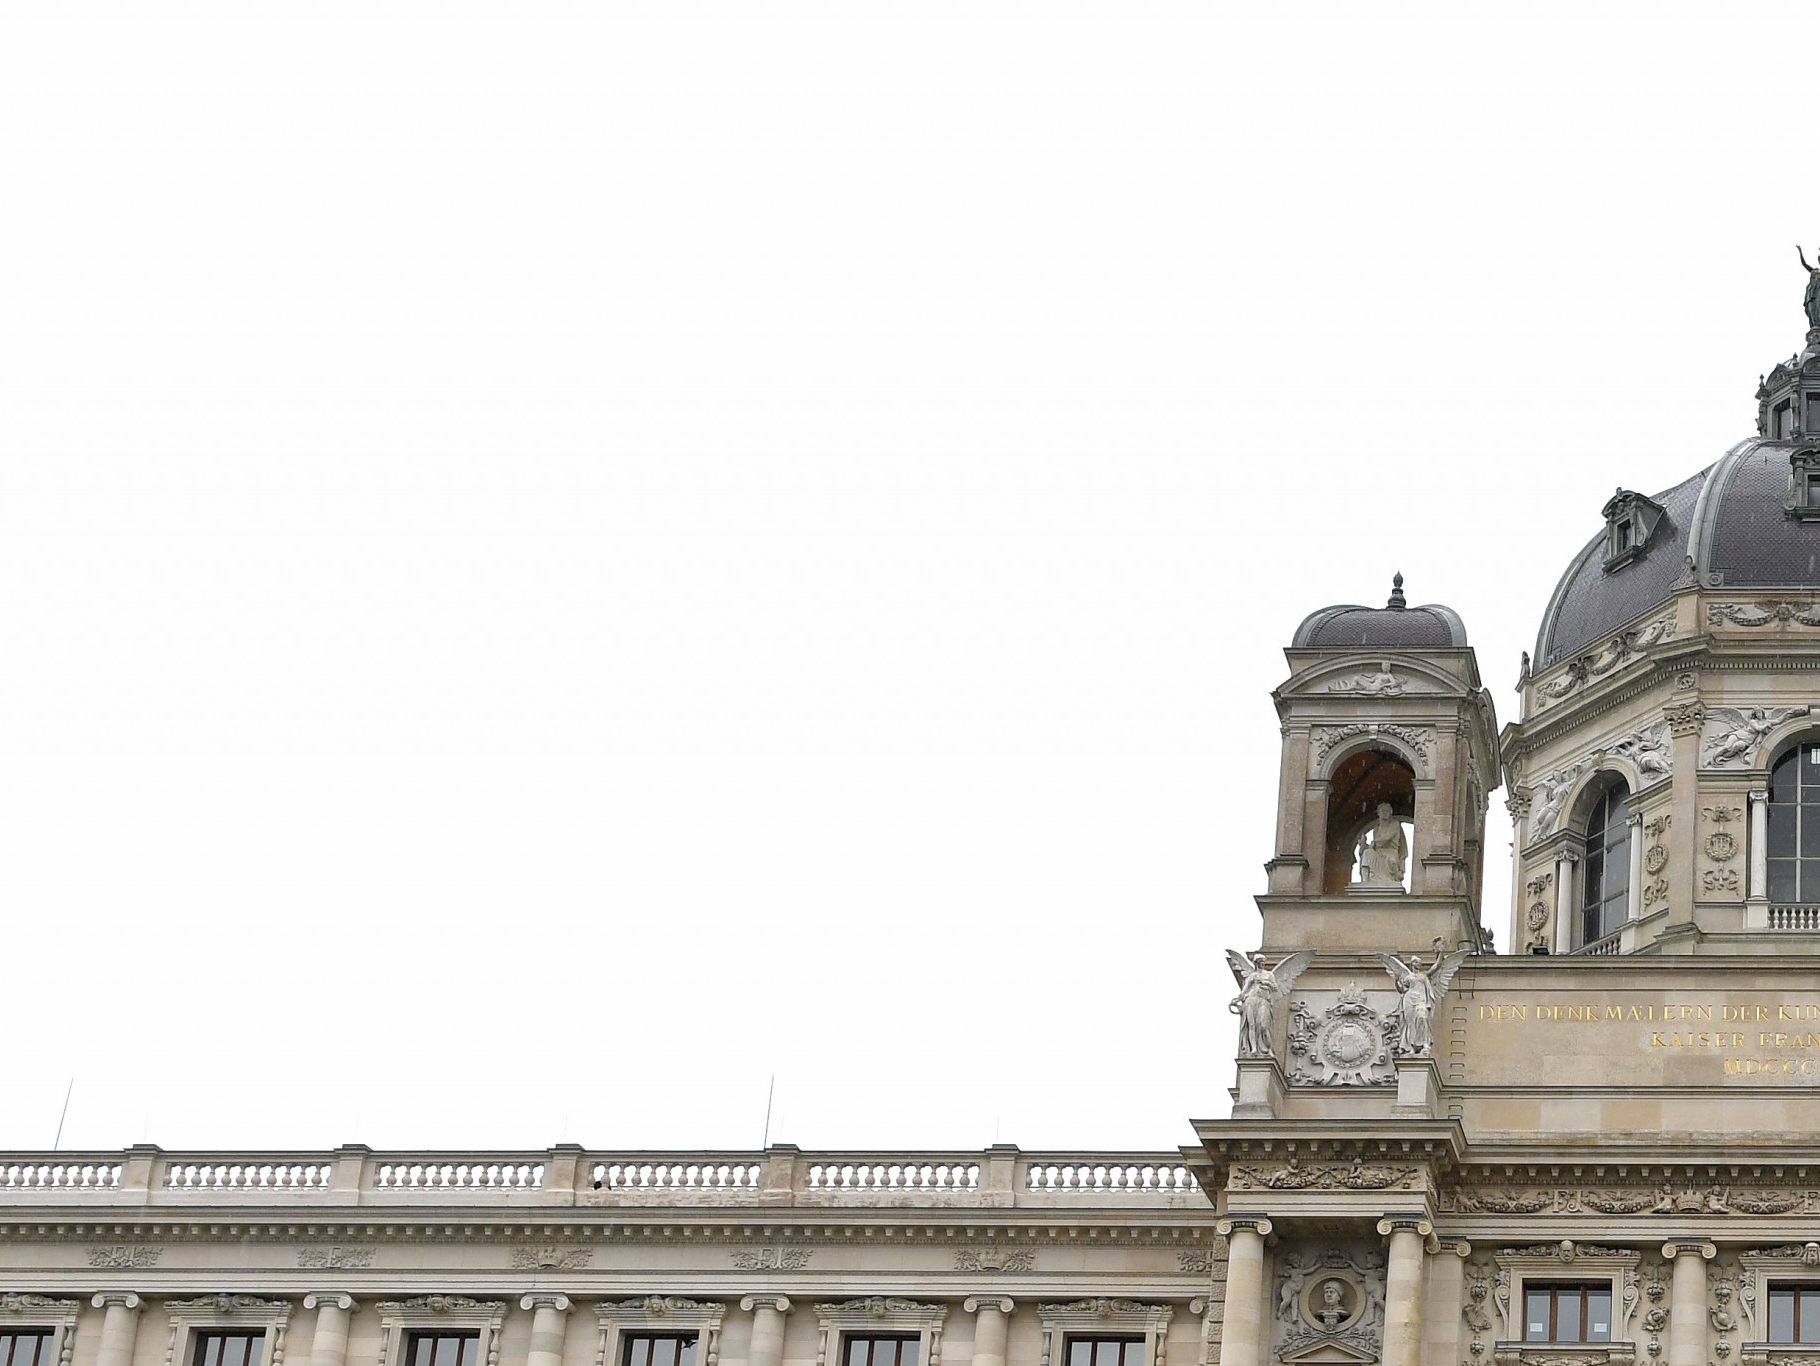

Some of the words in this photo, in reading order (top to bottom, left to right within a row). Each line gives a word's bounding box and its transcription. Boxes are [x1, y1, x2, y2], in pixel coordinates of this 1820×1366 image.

[1479, 1004, 1527, 1021] DEN
[1722, 1004, 1769, 1021] DER
[1651, 1031, 1746, 1049] KAISER
